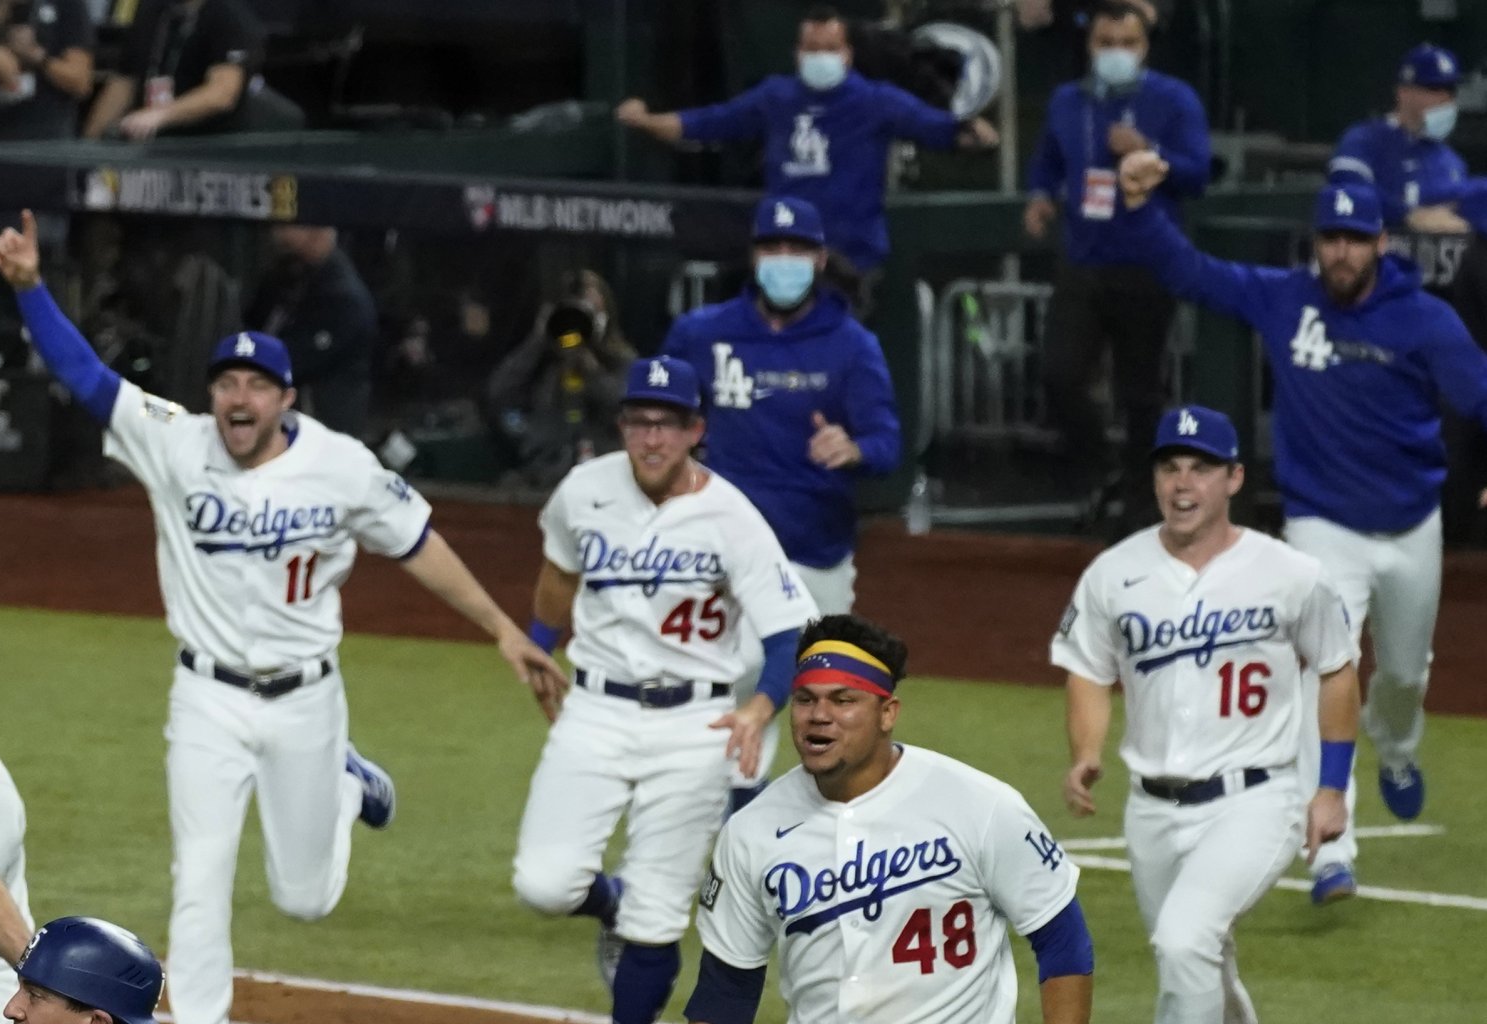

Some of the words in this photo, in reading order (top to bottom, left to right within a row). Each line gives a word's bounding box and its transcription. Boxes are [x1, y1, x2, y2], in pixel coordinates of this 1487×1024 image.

[499, 194, 547, 229] MLB
[554, 197, 674, 236] NETWORK
[1290, 305, 1334, 372] LA
[712, 342, 754, 410] LA
[185, 491, 337, 561] Dodgers
[285, 552, 320, 604] 11
[578, 530, 725, 598] Dodgers
[660, 594, 727, 644] 45
[1118, 601, 1279, 675] Dodgers
[1217, 660, 1271, 718] 16
[1024, 830, 1064, 872] LA
[765, 836, 962, 937] Dodgers
[892, 899, 978, 975] 48
